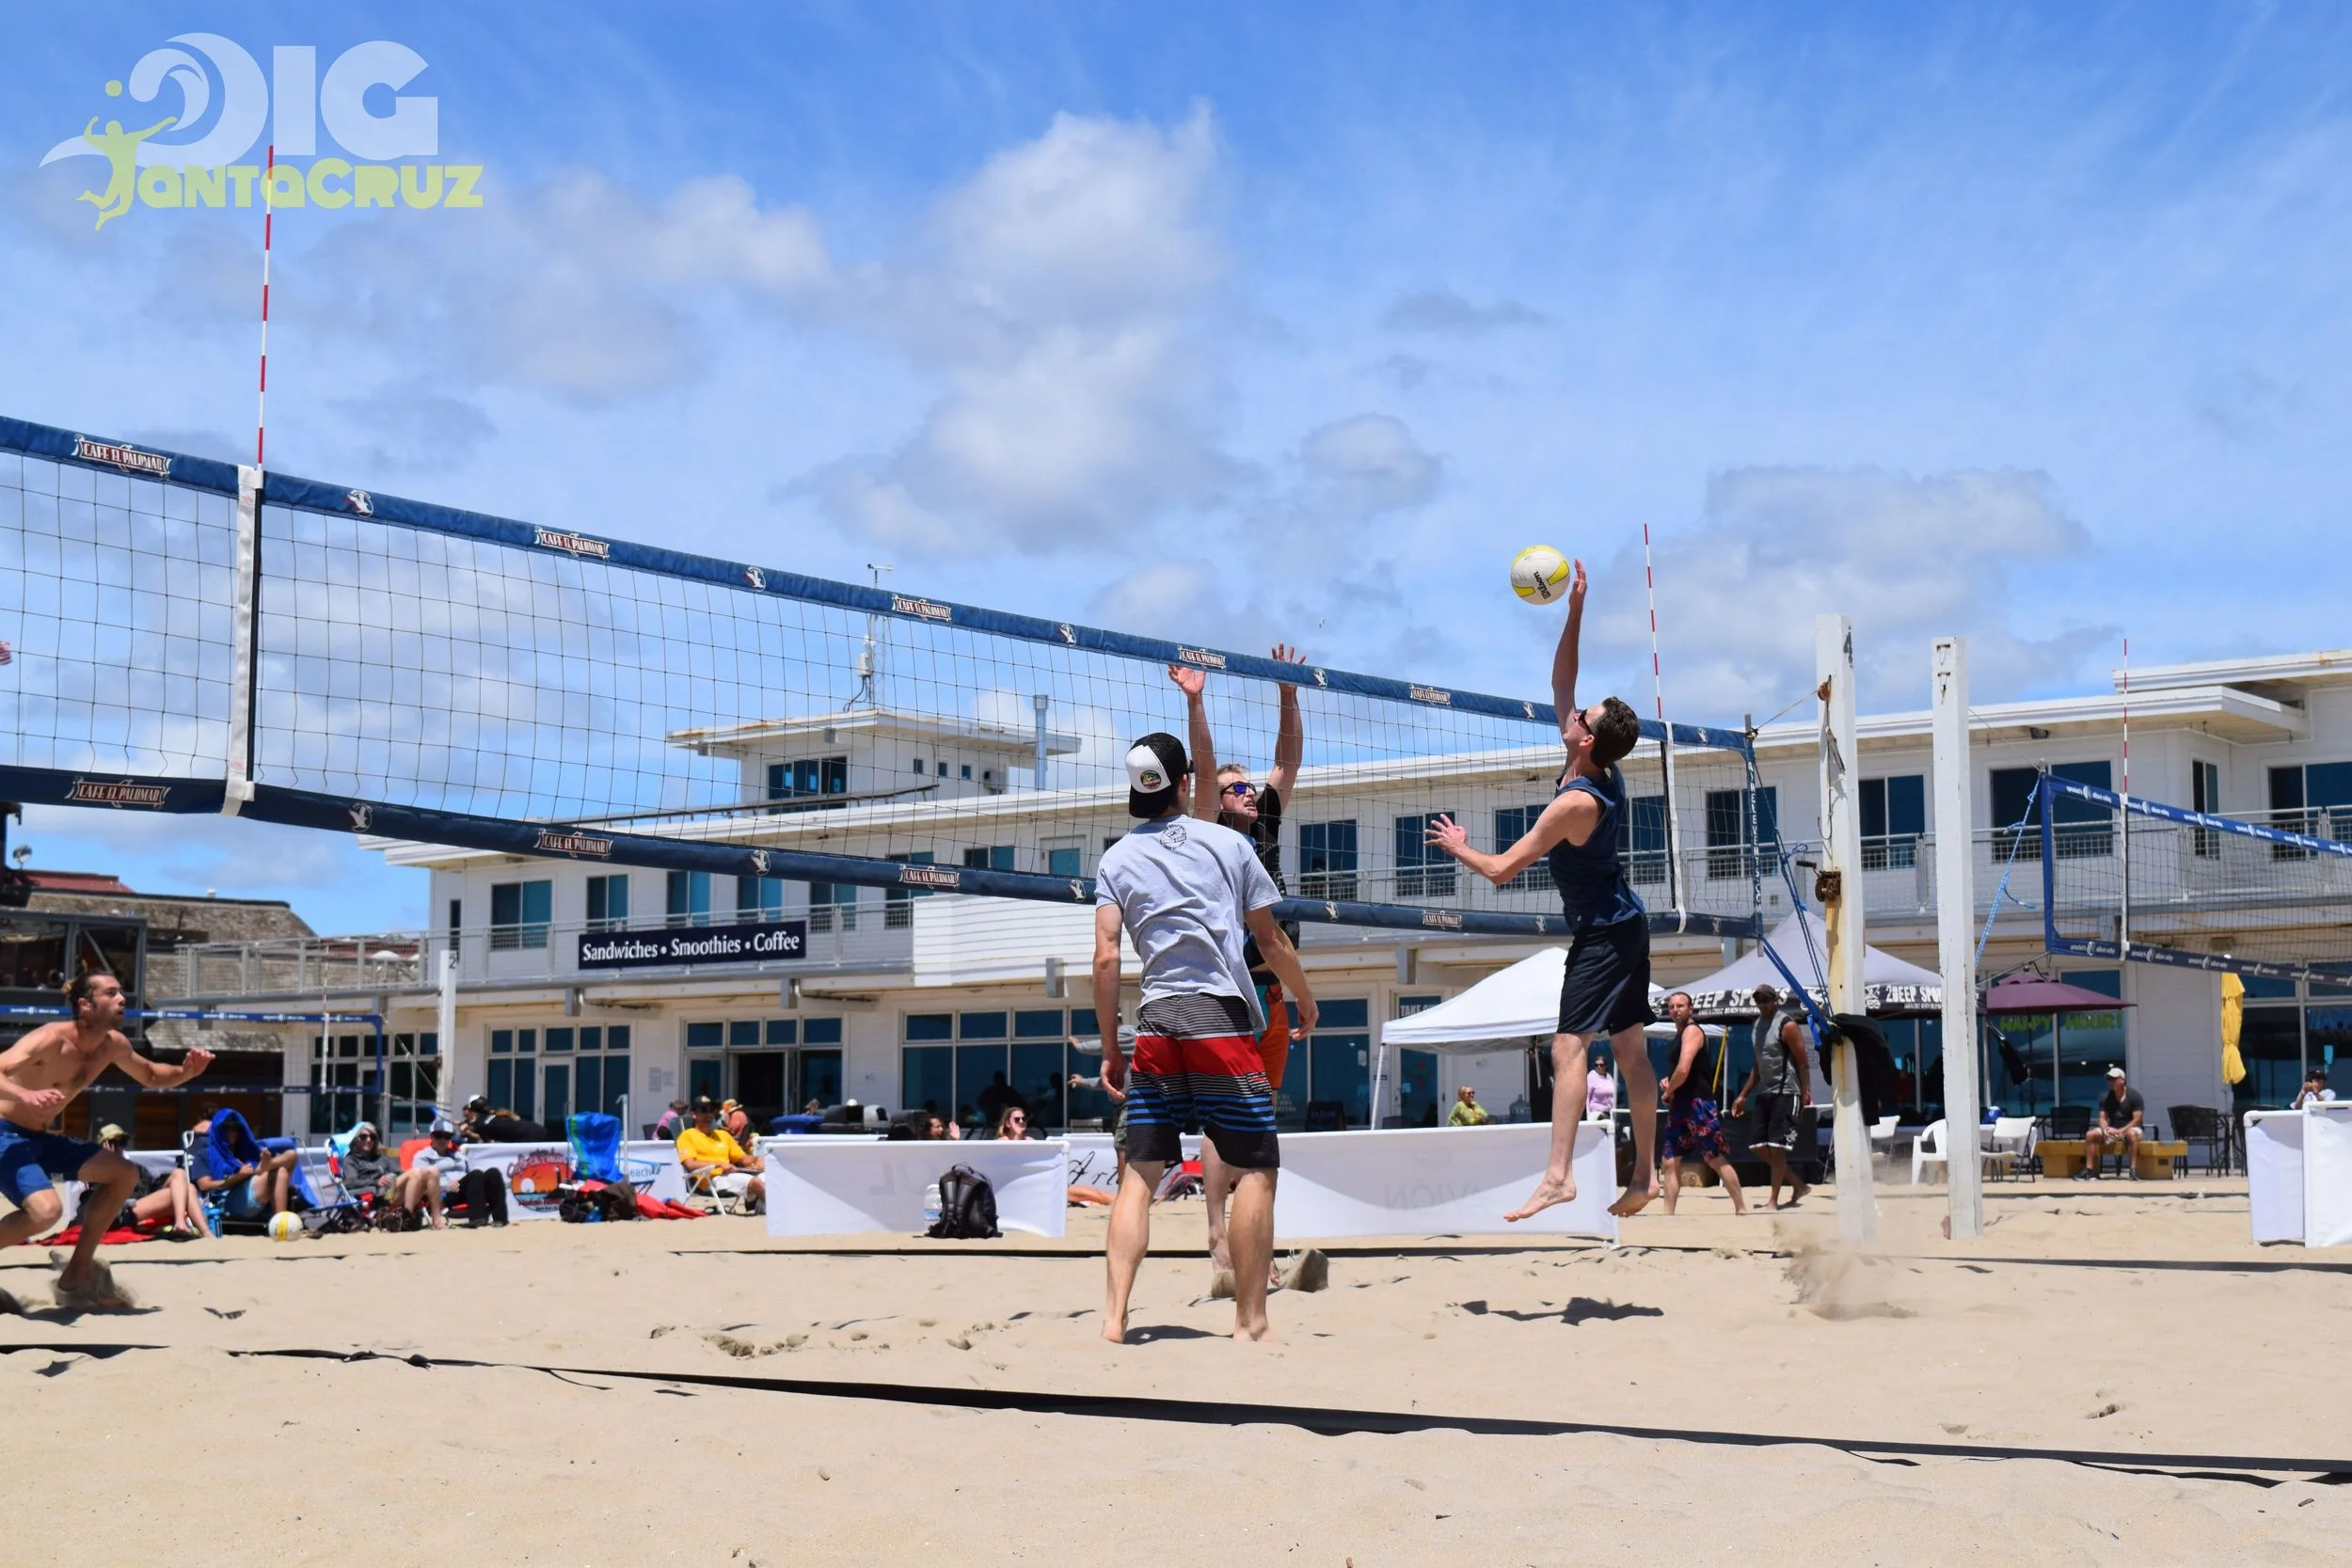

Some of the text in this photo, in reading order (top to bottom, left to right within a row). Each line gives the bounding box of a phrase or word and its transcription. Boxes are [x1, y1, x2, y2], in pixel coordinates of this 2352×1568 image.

[83, 443, 163, 470] CAFE EL PALOMAR
[1534, 570, 1551, 599] Wilson
[1843, 631, 1853, 664] 4
[79, 784, 161, 801] CAFE EL PALOMAR
[582, 930, 800, 961] Sandwiches Smoothies Coffee
[1692, 987, 1790, 1008] EEP SPOS
[1885, 985, 1942, 1003] 2DEEP SPOR
